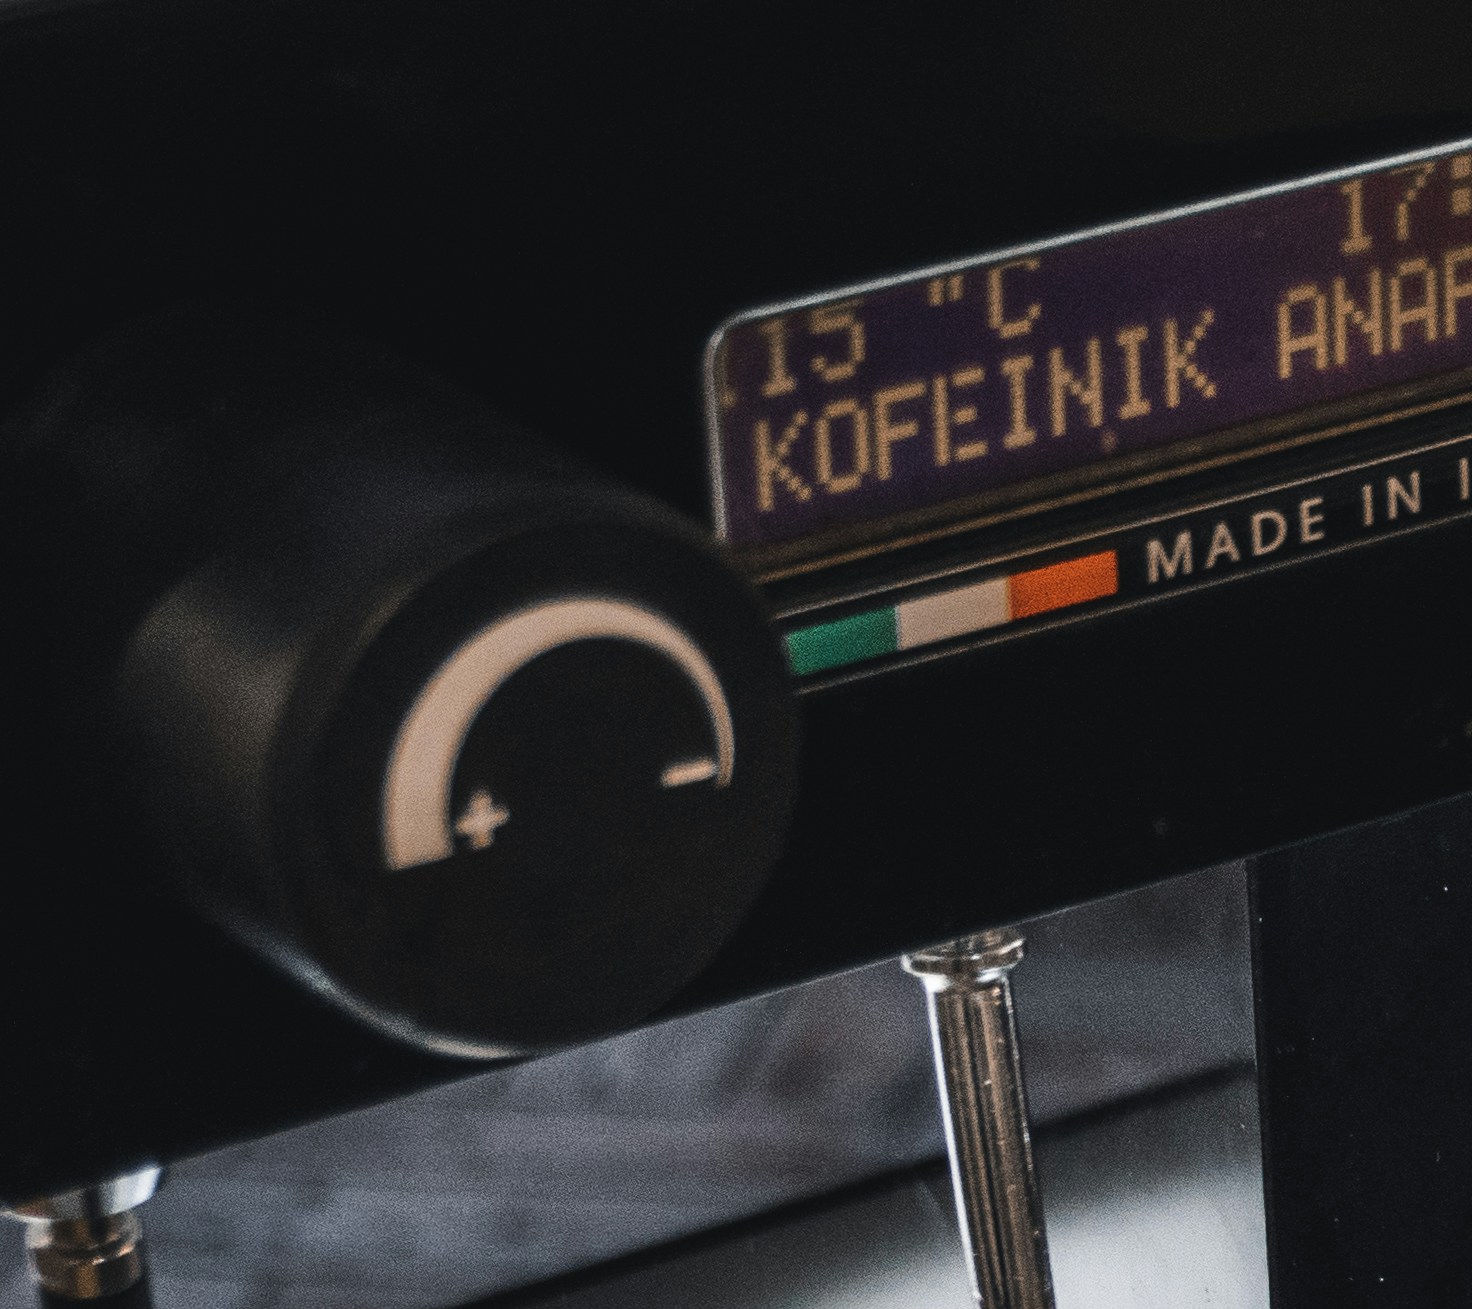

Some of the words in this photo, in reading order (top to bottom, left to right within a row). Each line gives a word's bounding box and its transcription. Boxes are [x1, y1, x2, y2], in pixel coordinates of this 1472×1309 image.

[720, 302, 868, 398] 15
[755, 308, 1217, 512] KOFEINIK
[1146, 497, 1325, 584] MADE
[1361, 470, 1422, 528] IN
